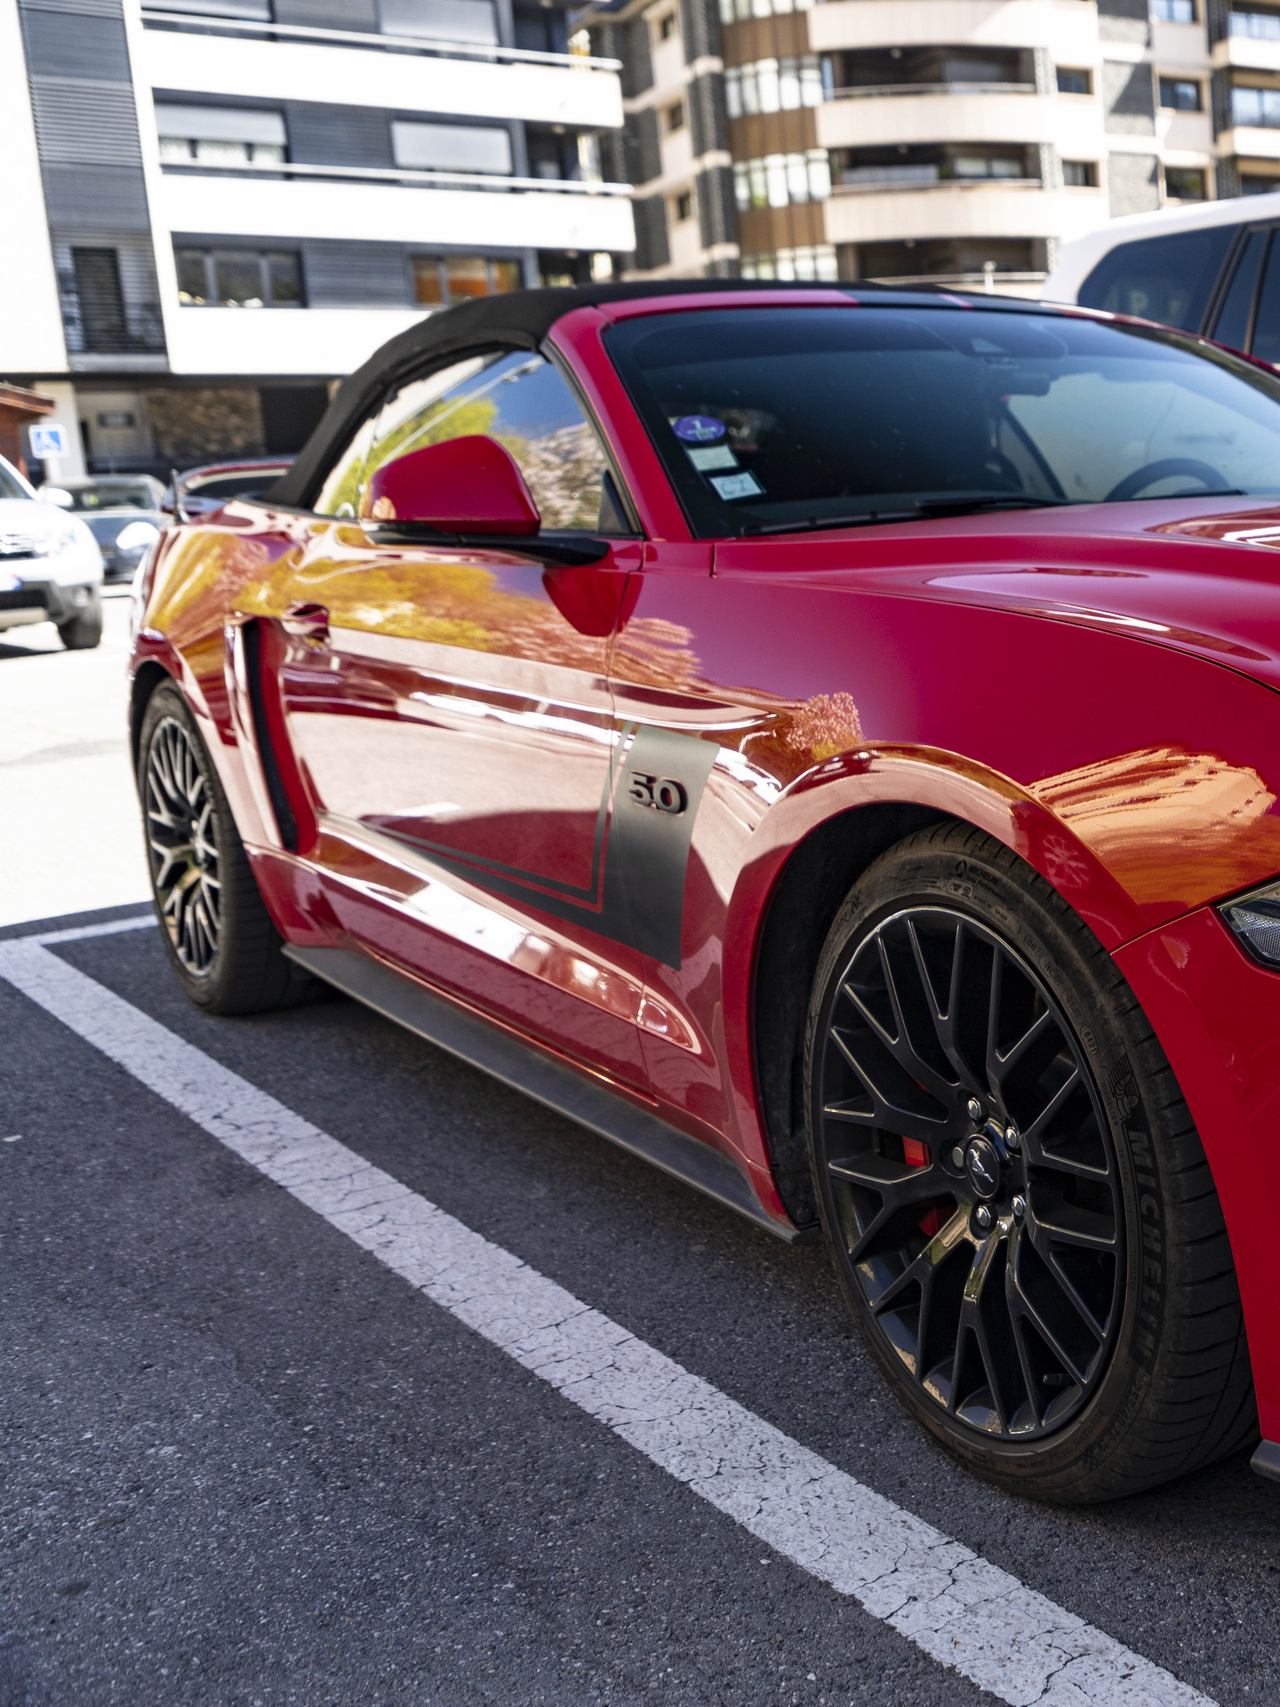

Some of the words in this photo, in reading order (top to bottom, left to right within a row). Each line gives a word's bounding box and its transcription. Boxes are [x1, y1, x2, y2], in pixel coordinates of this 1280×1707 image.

[966, 873, 978, 884] Total
[977, 879, 1007, 903] Performance
[968, 864, 1000, 886] MICHELIN
[1128, 1130, 1162, 1360] MICHELIN
[1116, 1384, 1141, 1426] 255/40
[1099, 1440, 1110, 1453] 19
